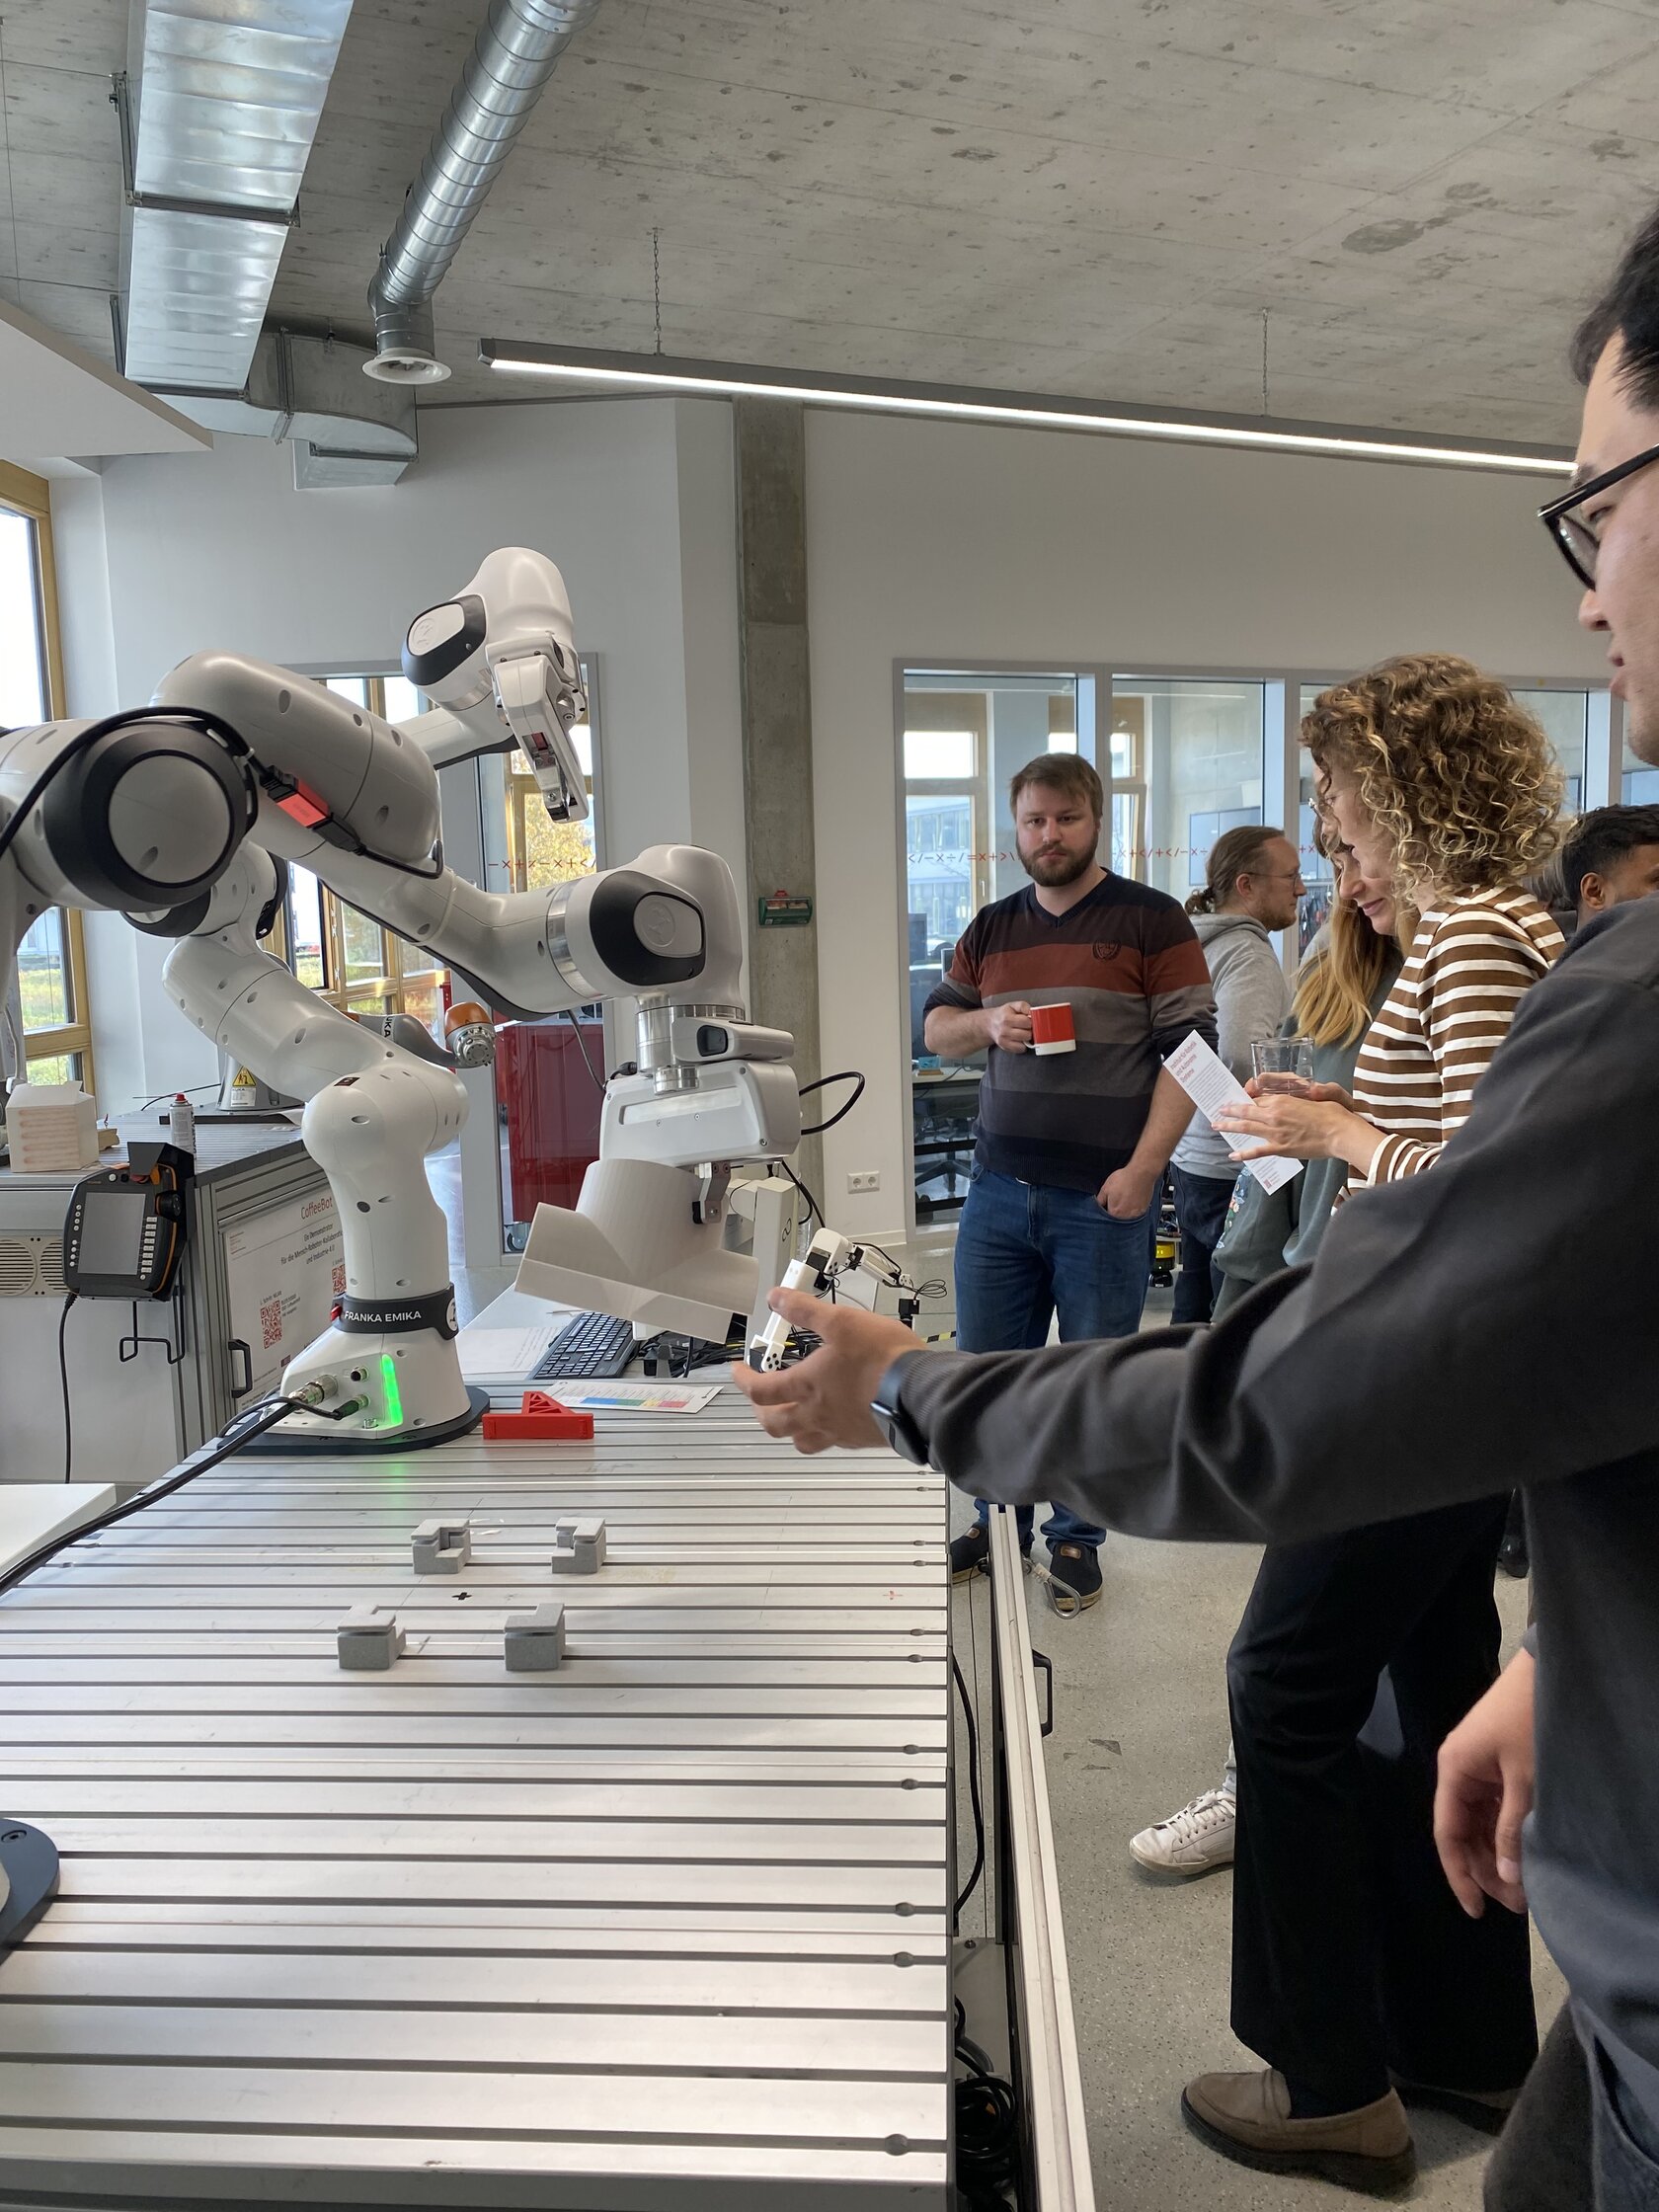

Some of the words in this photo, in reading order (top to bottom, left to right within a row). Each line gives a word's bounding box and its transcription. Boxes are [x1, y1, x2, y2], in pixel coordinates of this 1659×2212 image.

[384, 1015, 393, 1038] UKA
[300, 1196, 333, 1220] CoffeeBot
[309, 1224, 334, 1239] Demonstrator
[344, 1310, 382, 1323] FRANKA
[384, 1310, 422, 1323] EMIKA
